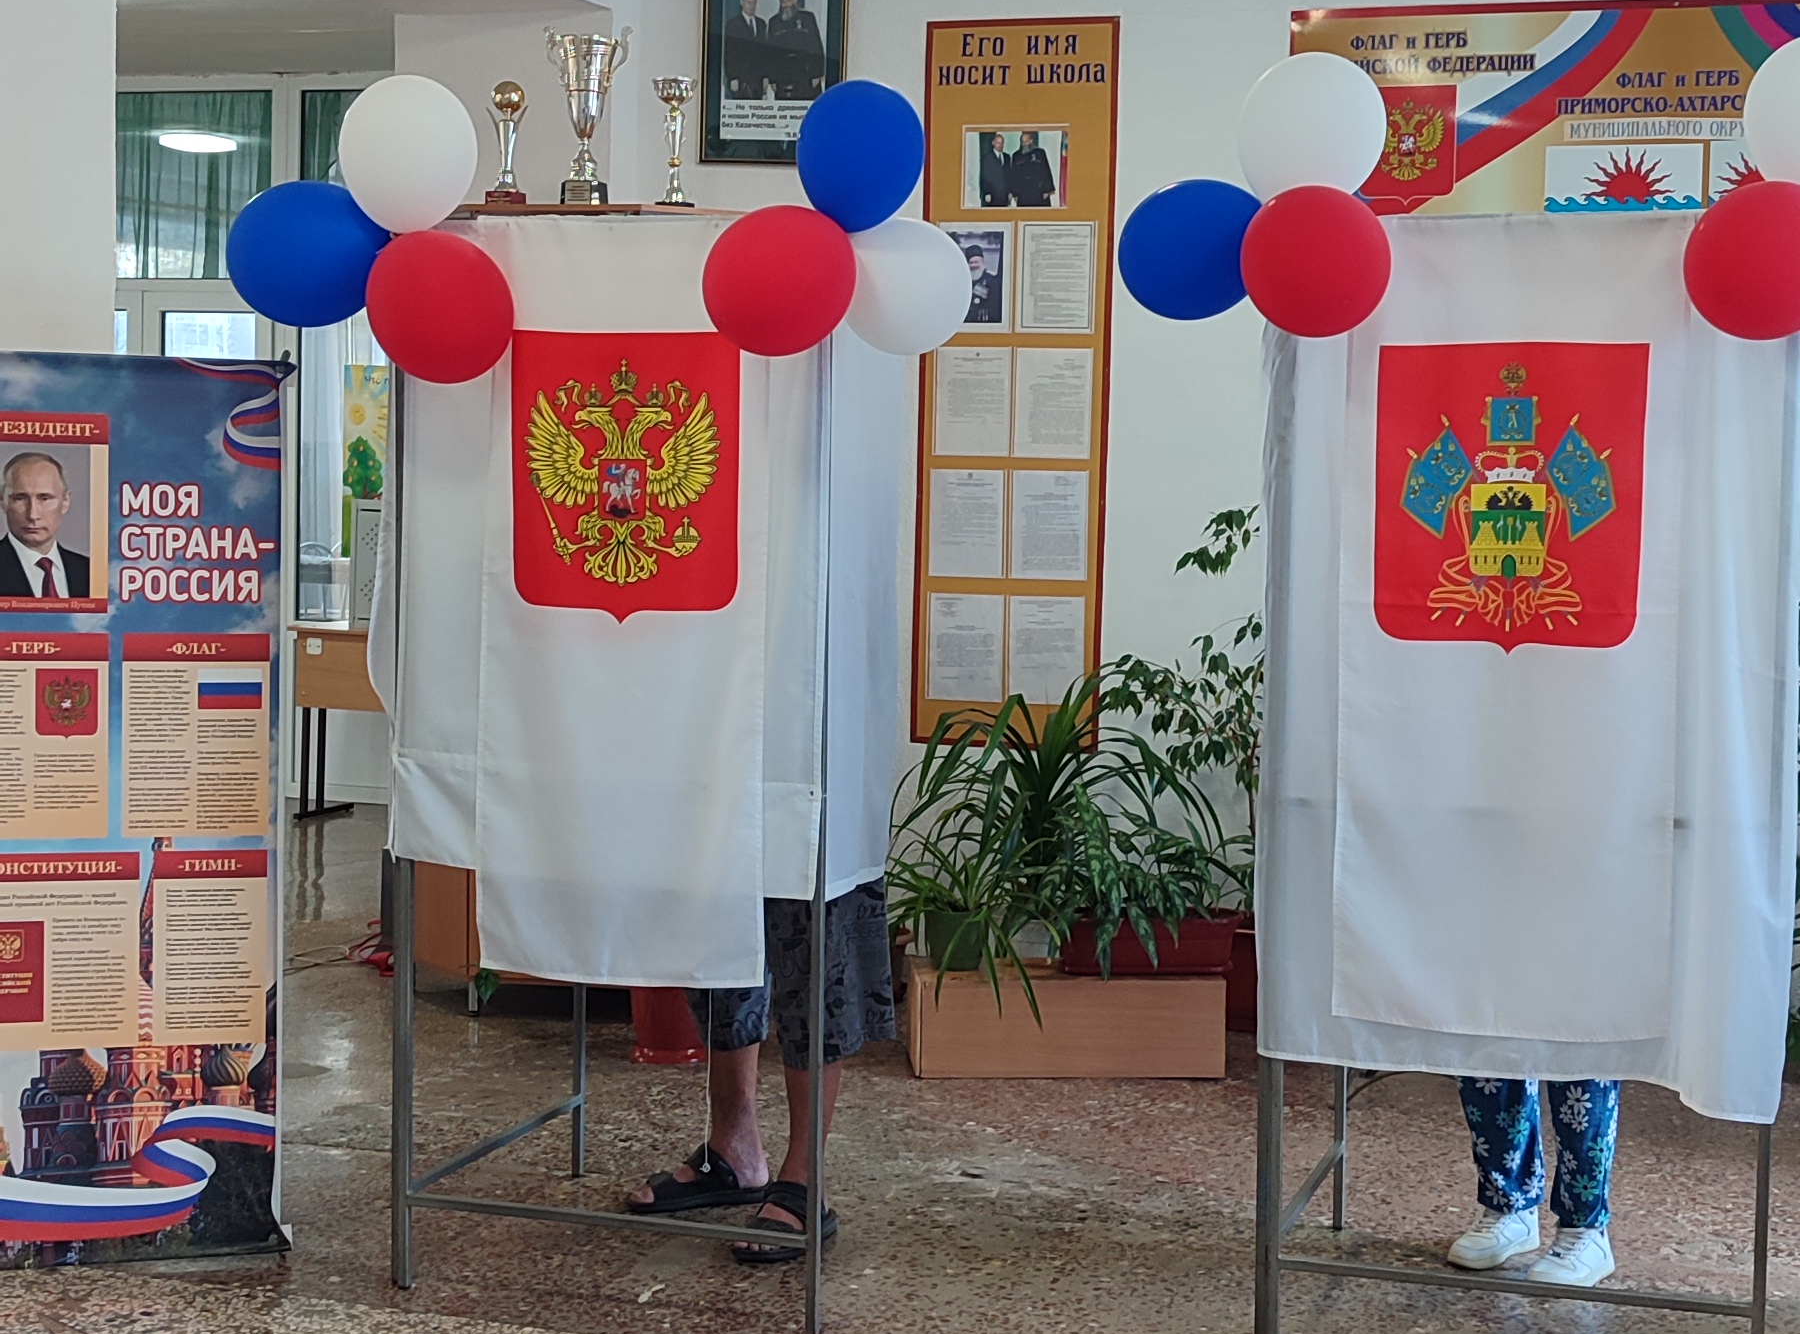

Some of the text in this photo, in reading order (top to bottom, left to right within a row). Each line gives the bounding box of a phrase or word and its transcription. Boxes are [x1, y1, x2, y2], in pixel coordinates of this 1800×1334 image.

[961, 33, 1078, 57] Его имя
[1350, 31, 1468, 50] ФЛАГ и ГЕРБ
[938, 63, 1106, 86] носит школа
[1426, 53, 1537, 77] ФЕДЕРАЦИИ
[1616, 70, 1740, 88] ФЛАГ и ГЕРБ
[1570, 120, 1703, 139] МУНИЦИПАЛЬНОГО
[0, 421, 100, 438] ЕЗИДЕНТ-
[121, 483, 200, 518] МОЯ
[120, 525, 276, 561] СТРАНА-
[120, 568, 260, 603] РОССИЯ
[4, 641, 61, 655] -ГЕРБ-
[165, 642, 227, 655] -ФЛАГ-
[178, 859, 243, 872] -ГИМН-
